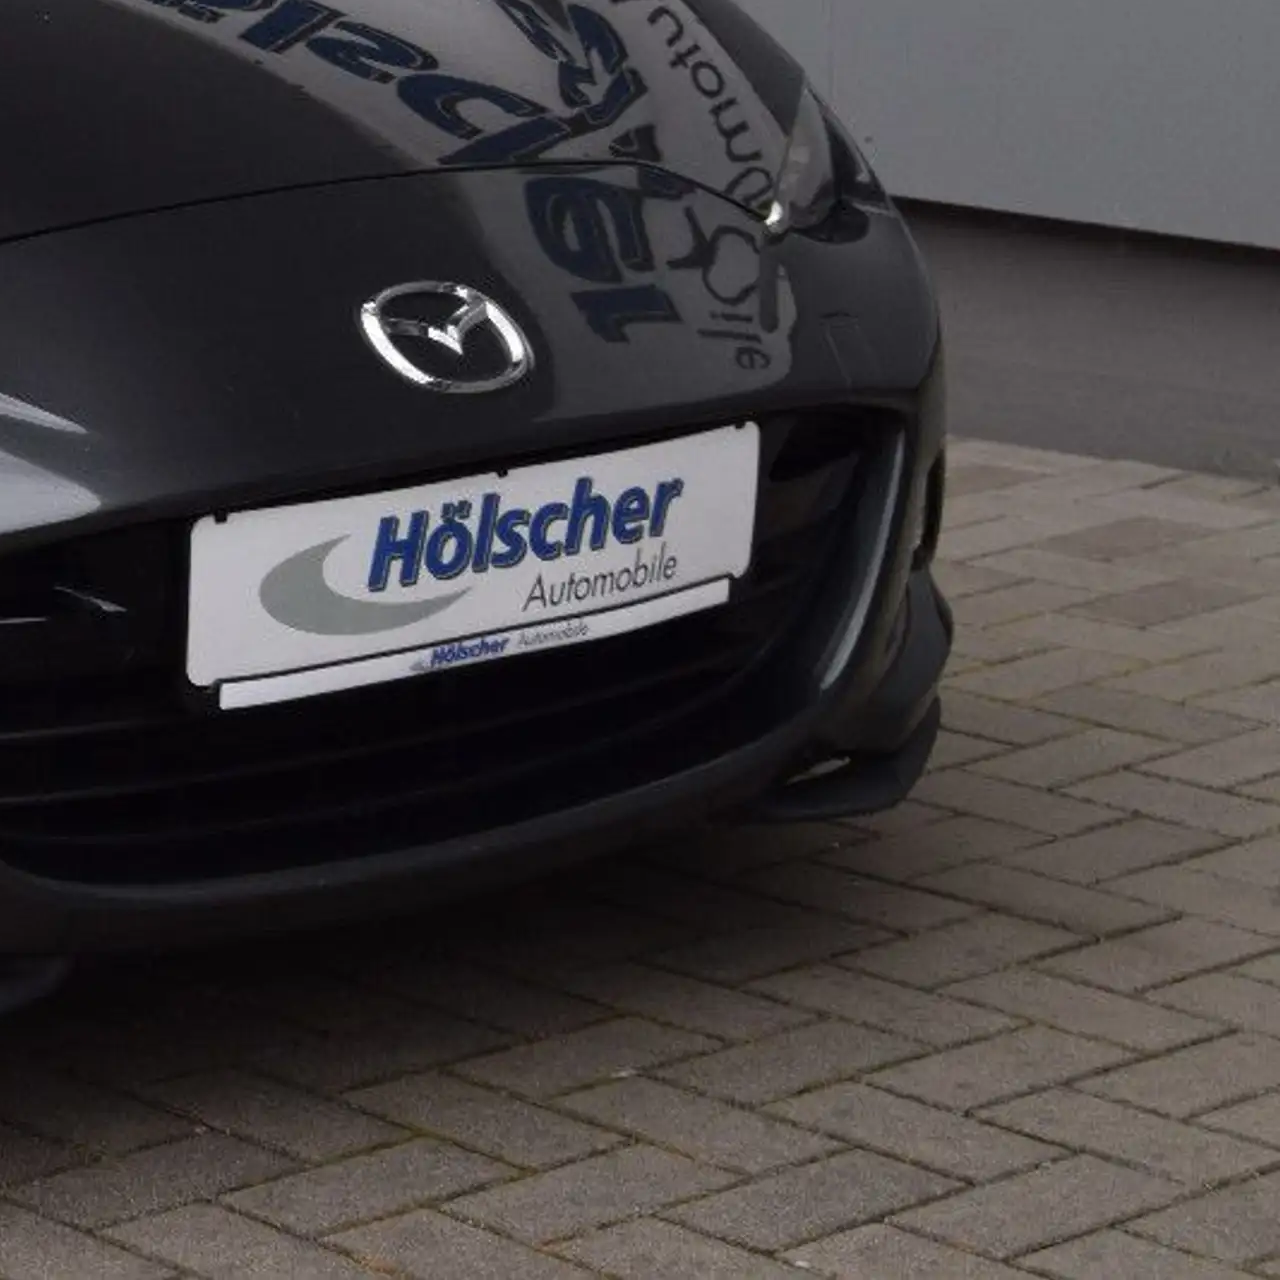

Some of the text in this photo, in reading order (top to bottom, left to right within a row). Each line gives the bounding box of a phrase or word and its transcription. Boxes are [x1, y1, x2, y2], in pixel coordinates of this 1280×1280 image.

[368, 476, 685, 593] Hölscher
[521, 542, 678, 613] Automobile
[430, 618, 590, 668] Hölscher Automobile
